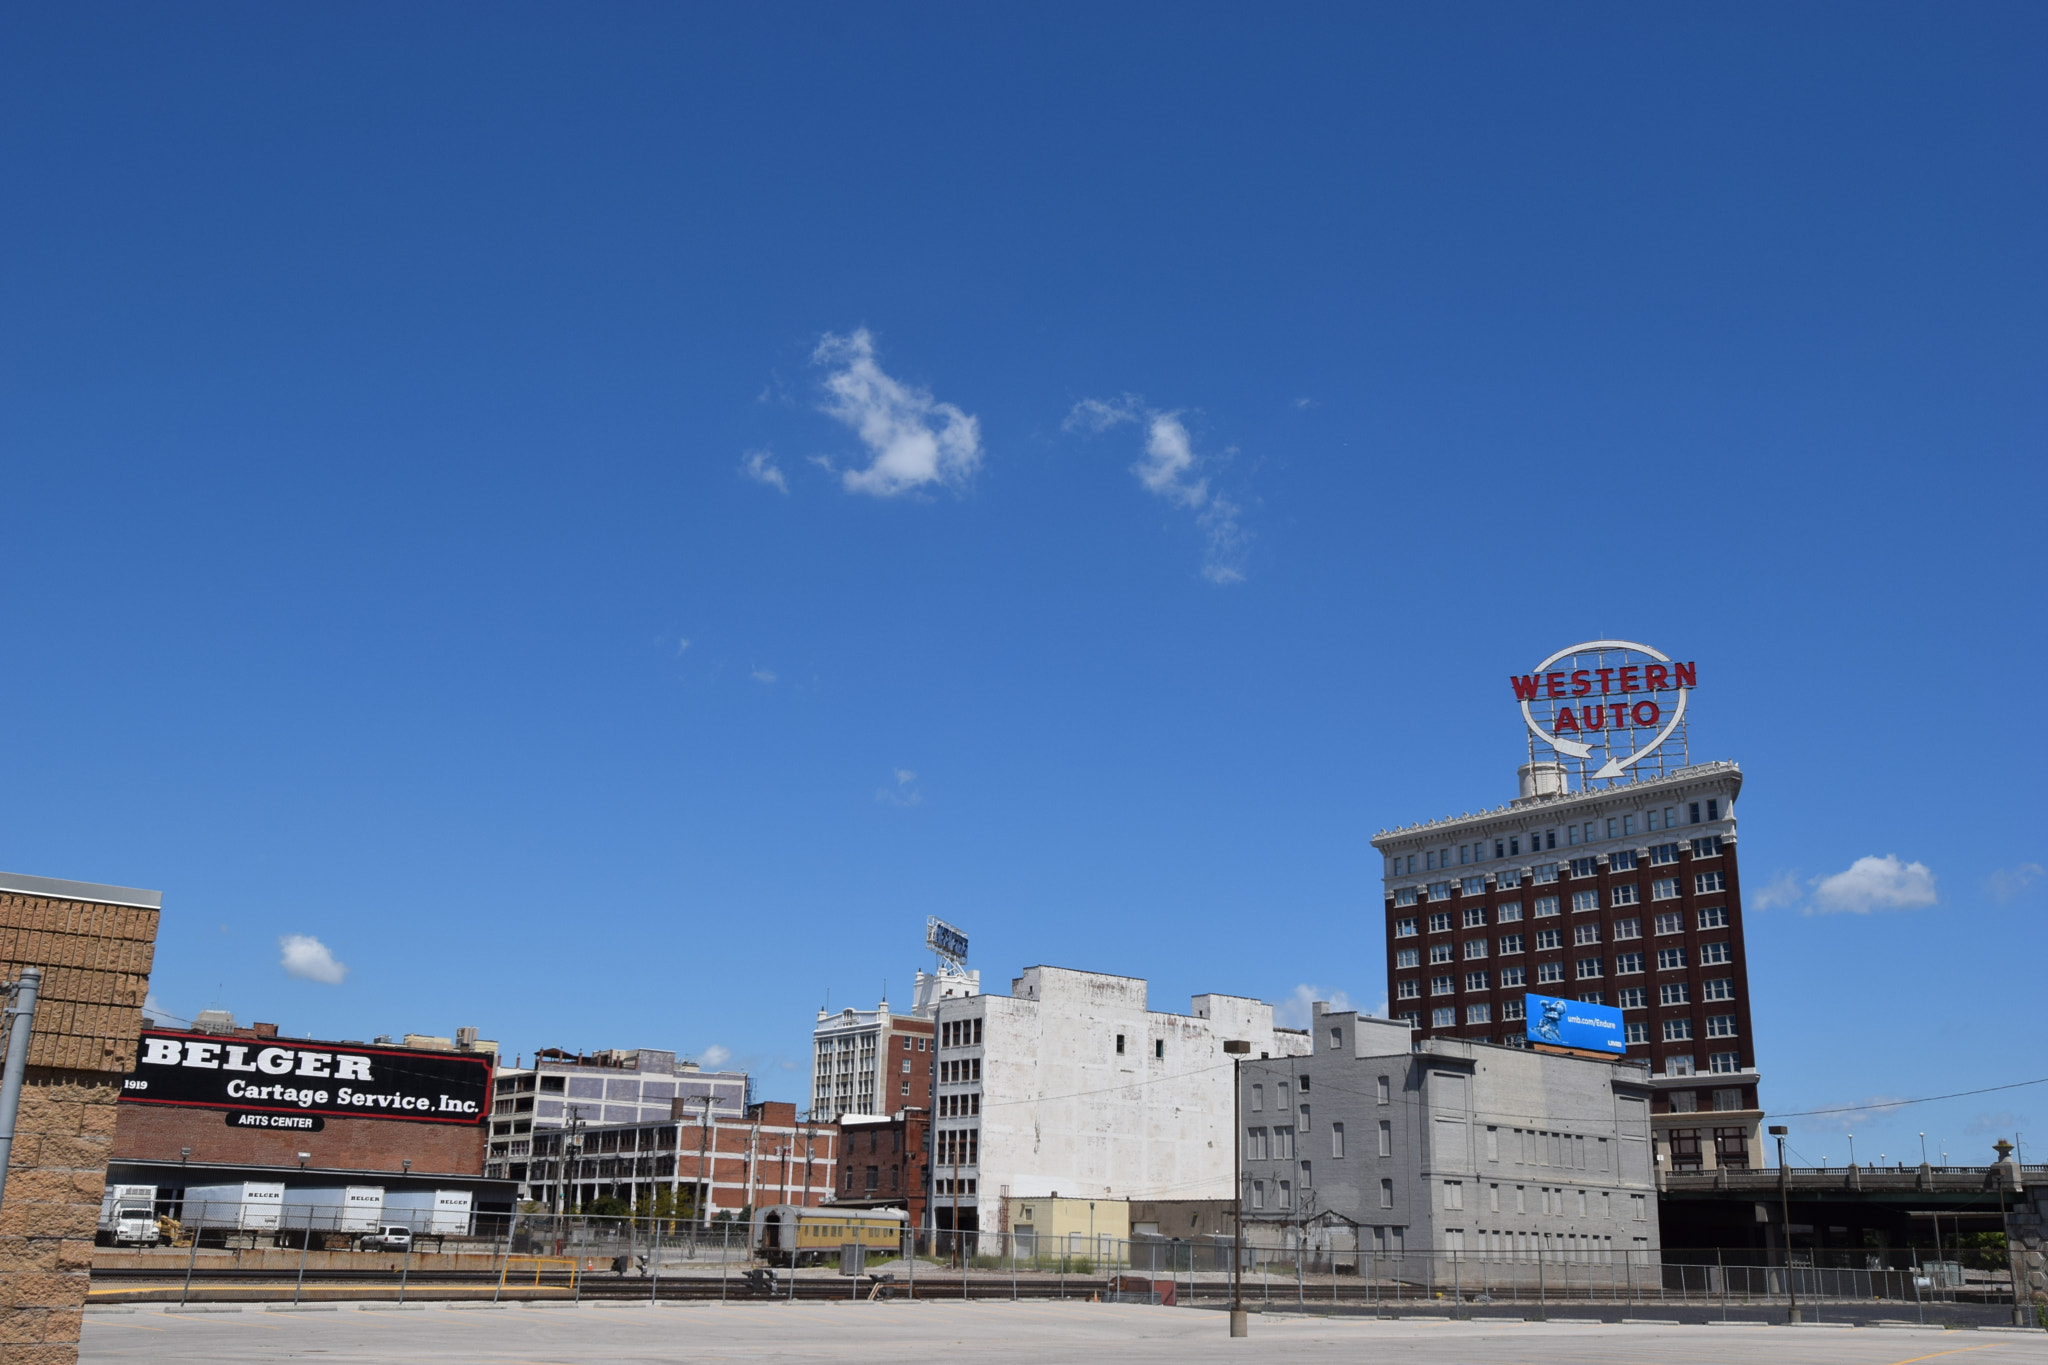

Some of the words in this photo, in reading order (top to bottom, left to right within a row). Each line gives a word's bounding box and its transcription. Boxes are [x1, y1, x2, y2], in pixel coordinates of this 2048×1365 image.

[1510, 662, 1697, 700] WESTERN
[1554, 700, 1660, 733] AUTO
[1567, 1015, 1616, 1030] umb.com/Endure
[142, 1038, 373, 1081] BELGER
[124, 1079, 148, 1090] 1919
[227, 1079, 329, 1108] Cartage
[337, 1087, 436, 1112] Service,
[439, 1094, 480, 1113] Inc.
[238, 1114, 269, 1127] ARTS
[270, 1115, 313, 1129] CENTER
